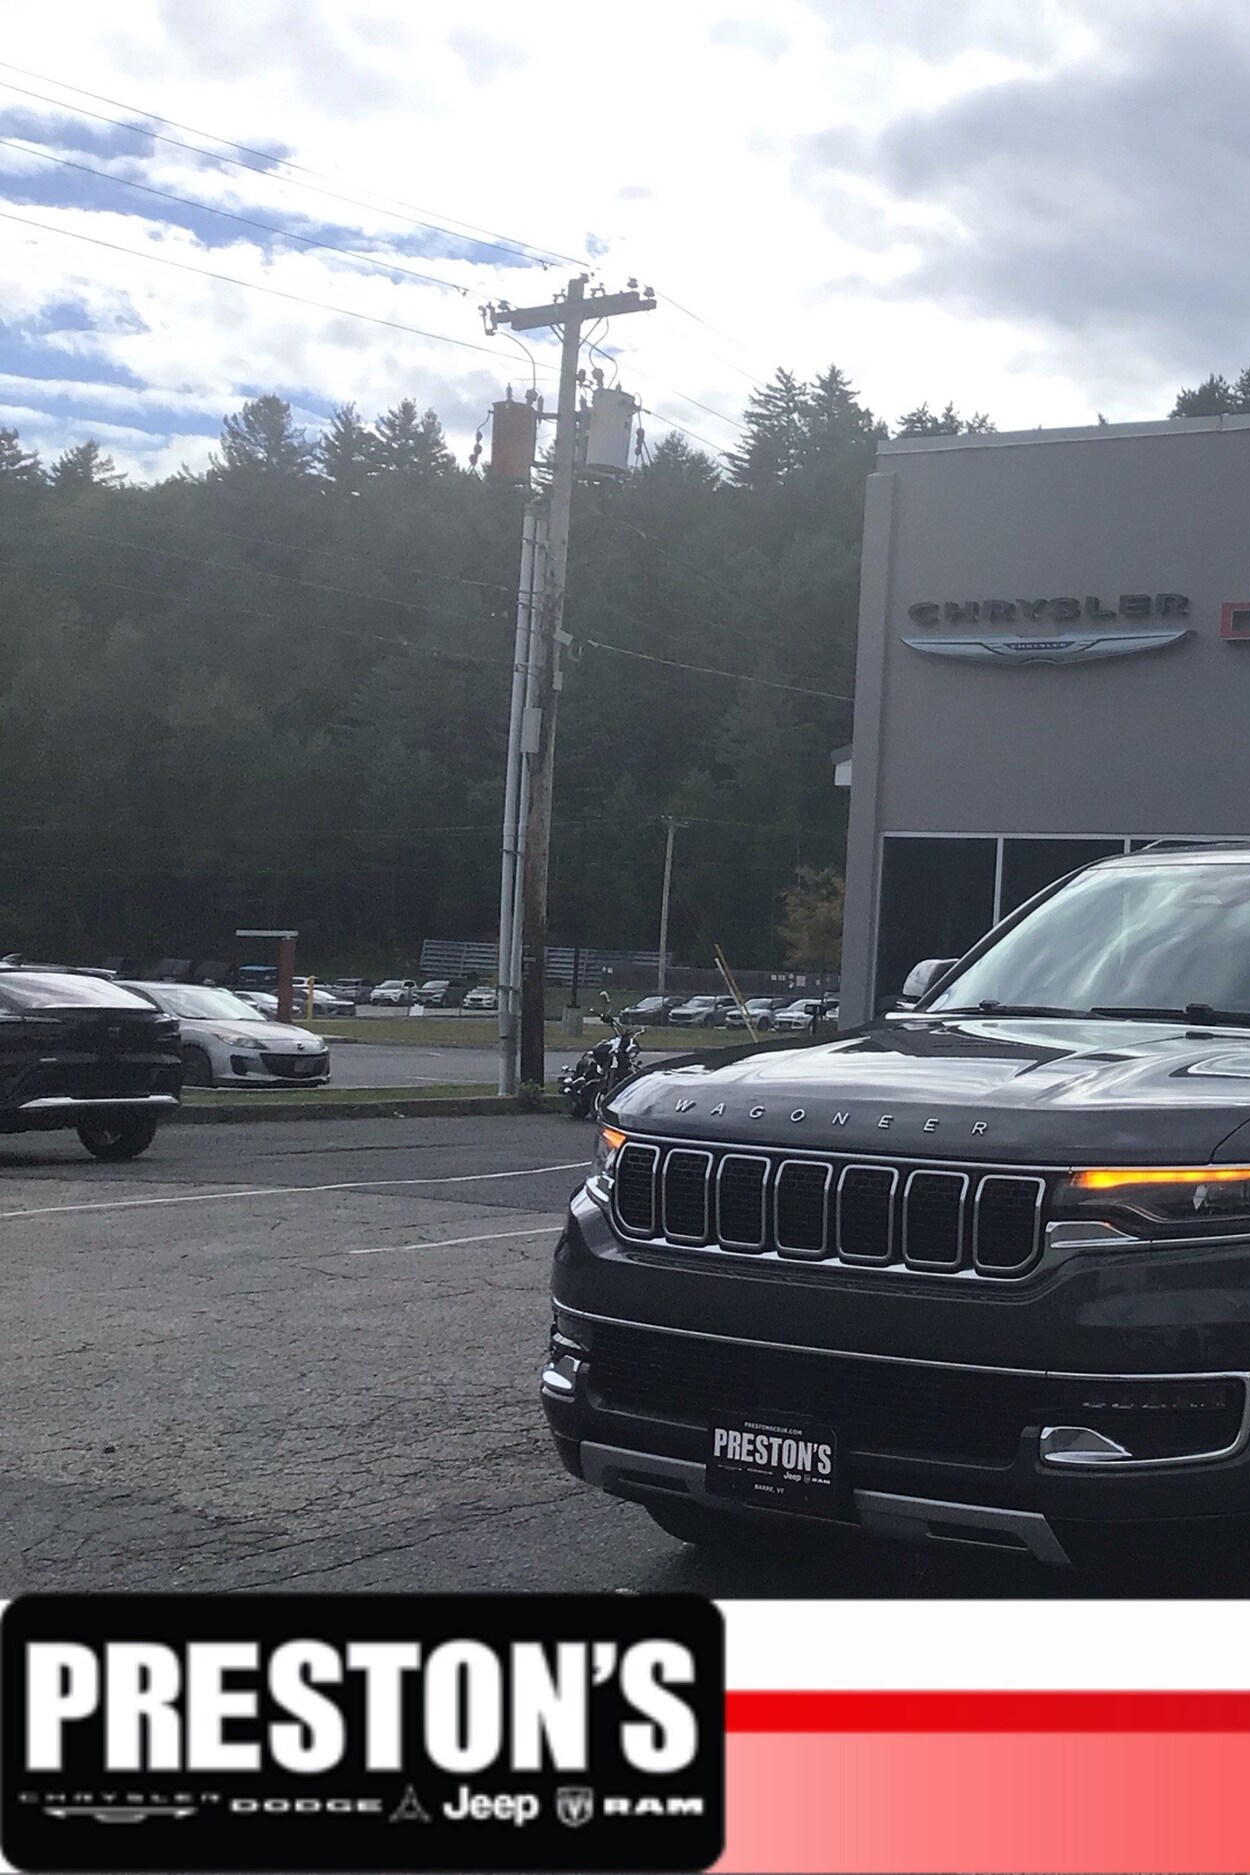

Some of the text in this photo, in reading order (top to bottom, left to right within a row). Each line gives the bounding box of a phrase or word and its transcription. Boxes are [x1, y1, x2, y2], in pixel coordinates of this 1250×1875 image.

[908, 593, 1190, 627] CHRYSLER
[1009, 641, 1068, 649] CHRYSLER
[675, 1099, 988, 1136] WAGONEER
[713, 1427, 832, 1475] PRESTON'S
[783, 1471, 802, 1482] Jeep
